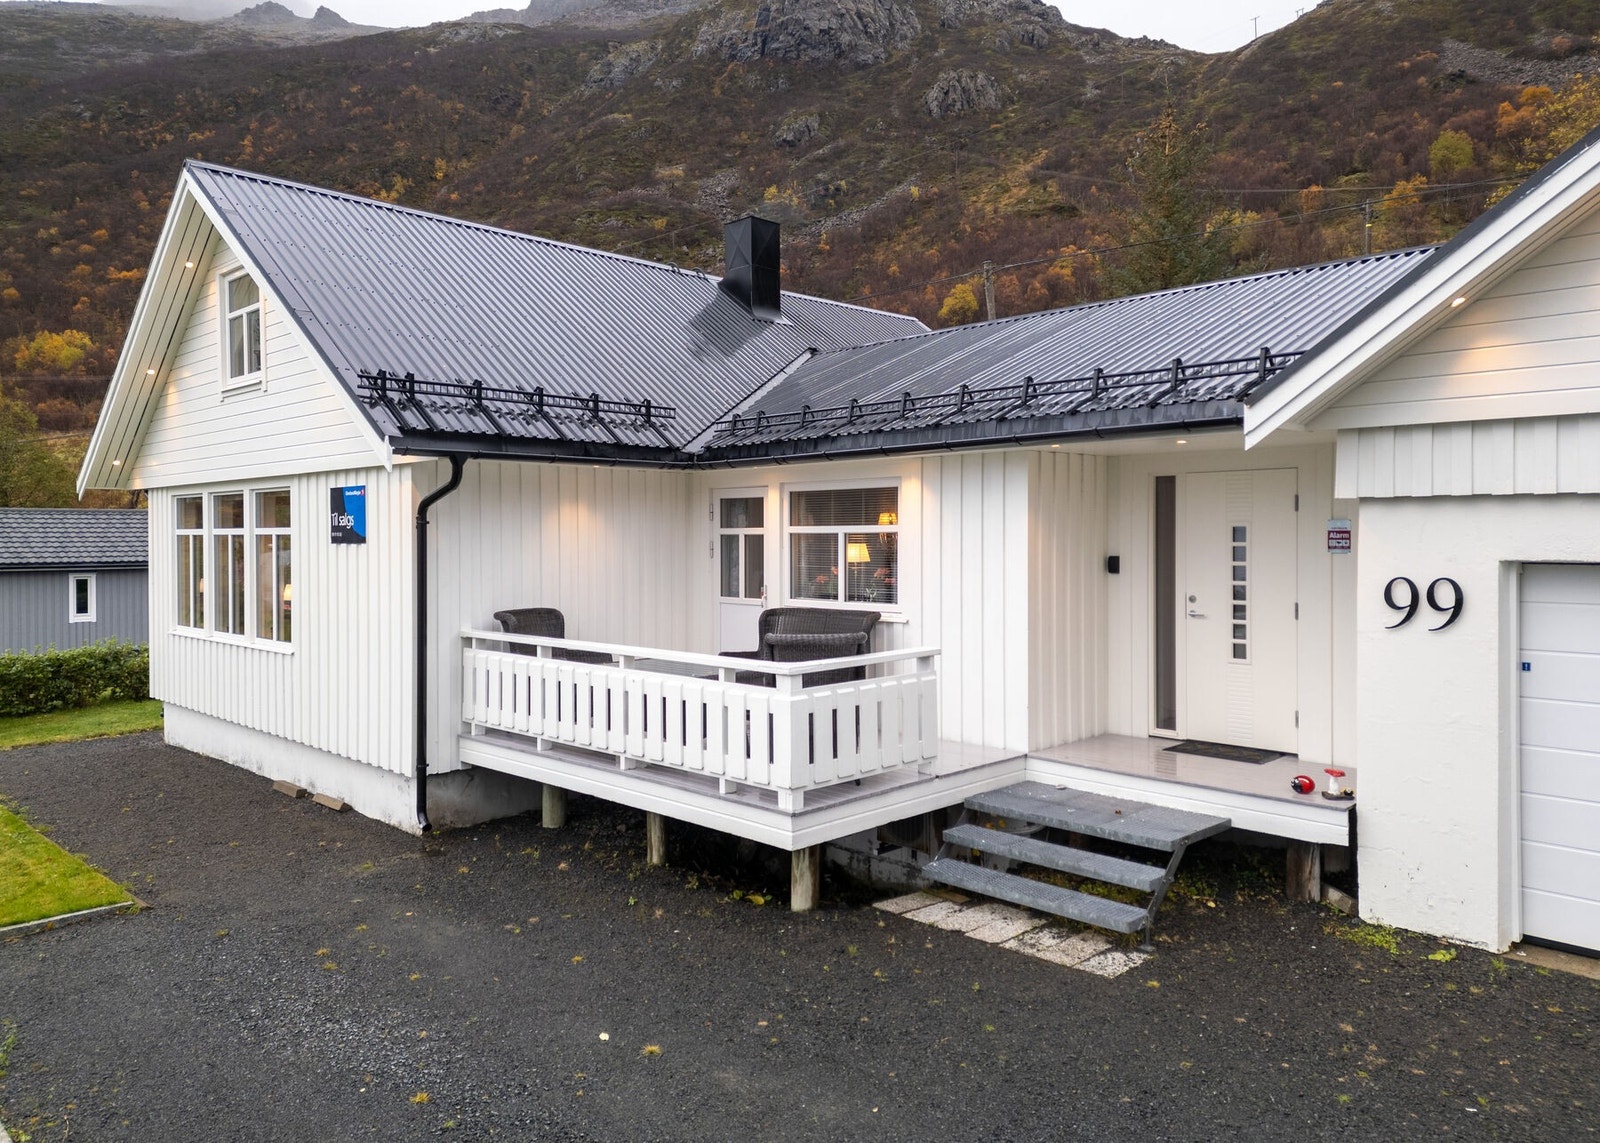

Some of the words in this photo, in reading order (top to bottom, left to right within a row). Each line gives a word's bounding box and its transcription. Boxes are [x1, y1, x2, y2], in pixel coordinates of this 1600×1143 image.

[339, 512, 354, 529] salgs
[1329, 531, 1349, 539] Alarm
[1384, 576, 1464, 631] 99
